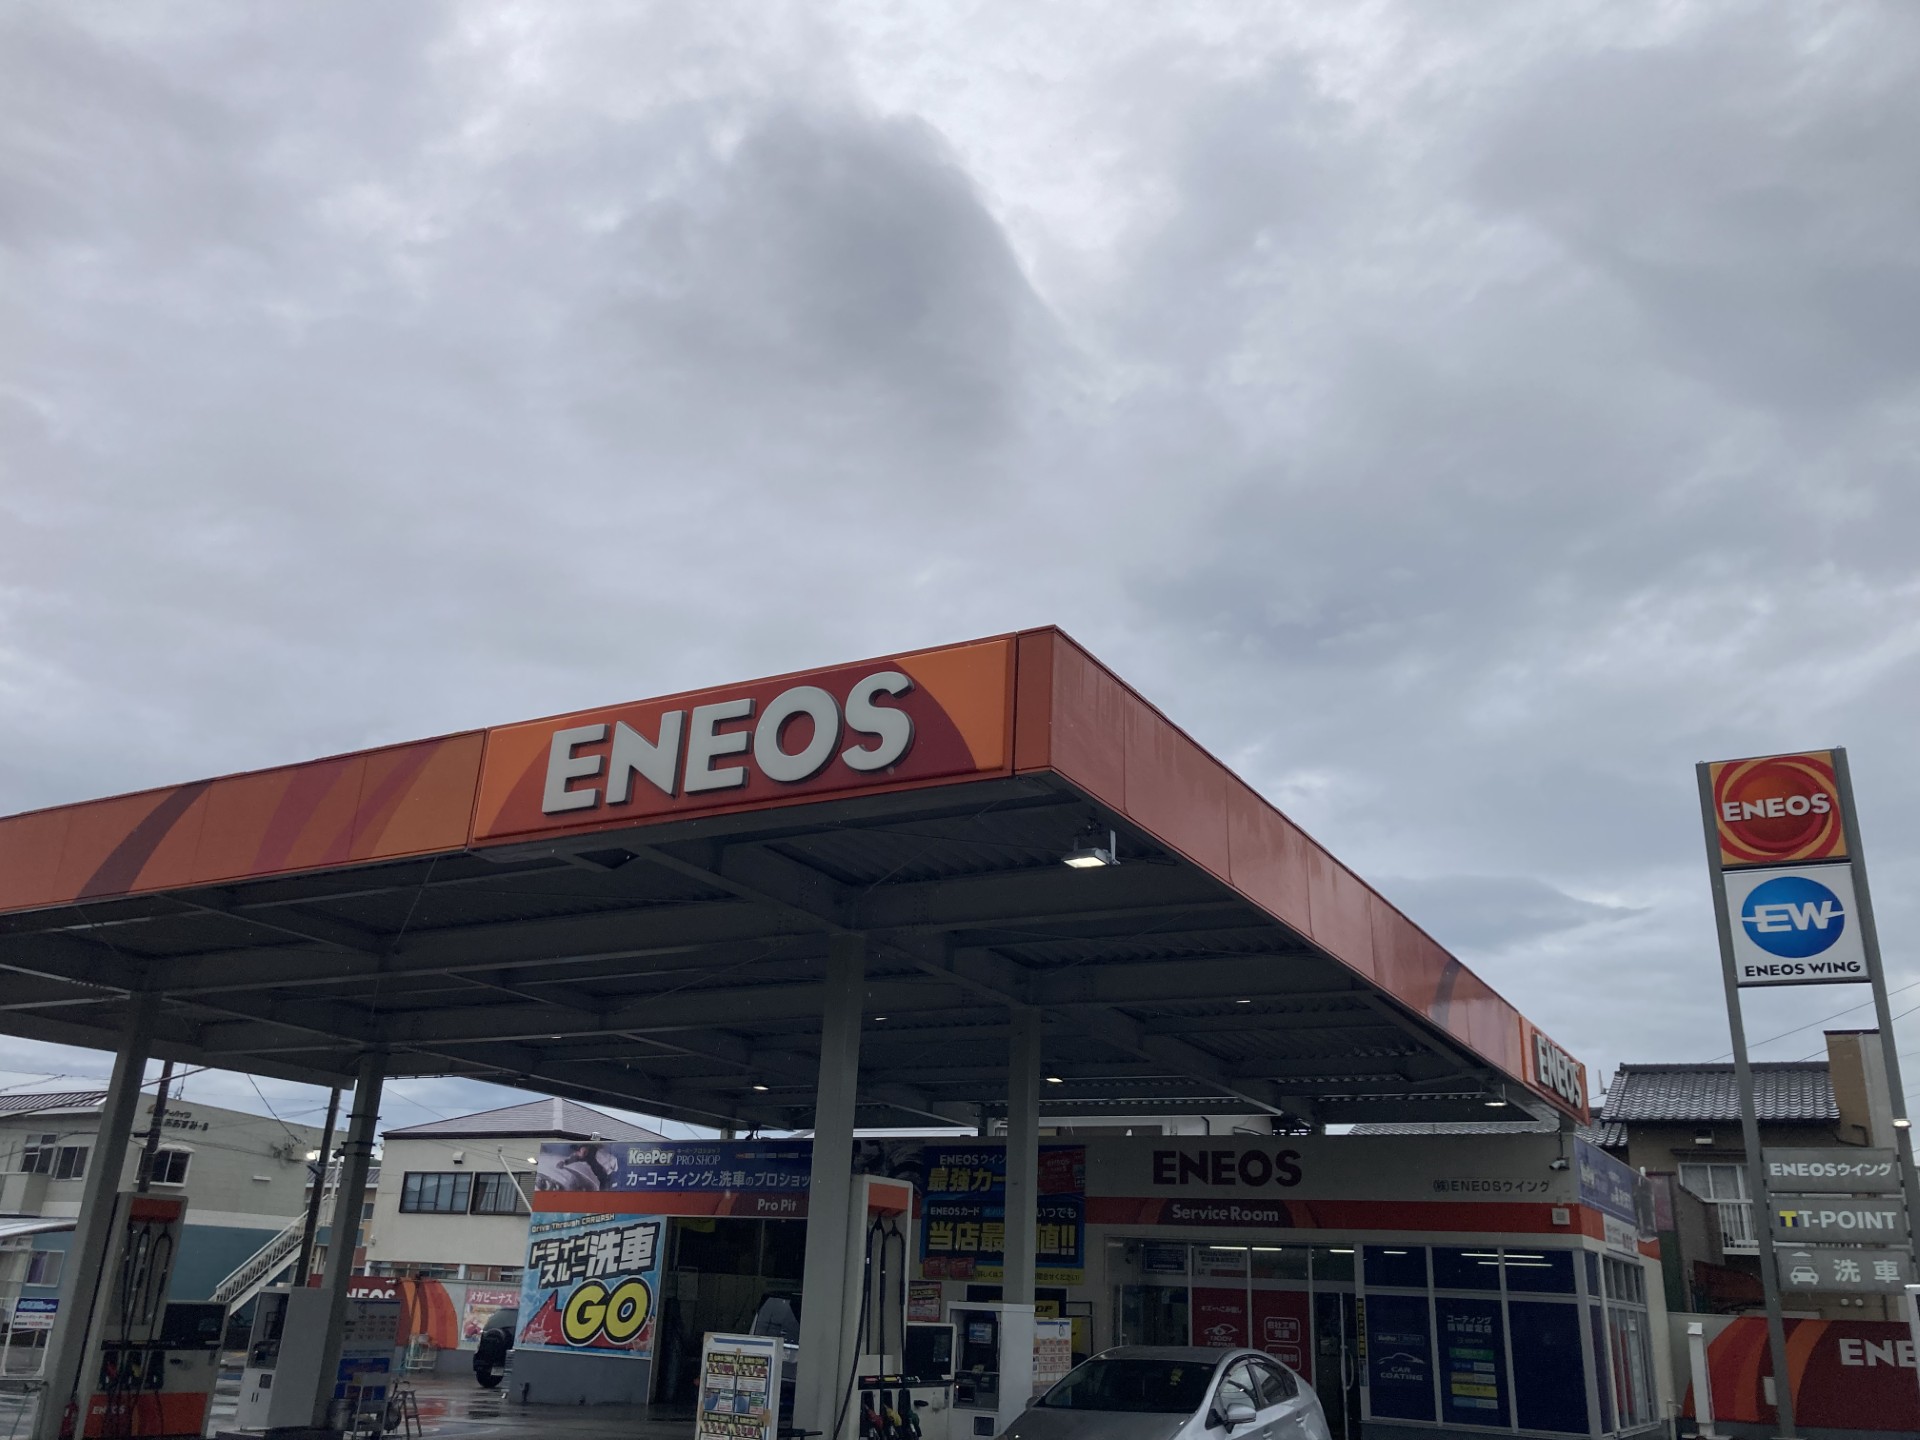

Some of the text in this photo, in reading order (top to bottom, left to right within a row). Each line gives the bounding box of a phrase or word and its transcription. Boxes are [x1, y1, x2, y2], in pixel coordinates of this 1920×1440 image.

[541, 670, 915, 813] ENEOS
[1721, 792, 1831, 823] ENEOS
[1744, 960, 1861, 977] ENEOS WING
[1535, 1033, 1583, 1110] ENEOS
[628, 1148, 674, 1166] KeePer
[676, 1154, 695, 1166] PRO
[695, 1154, 721, 1166] SHOP
[1153, 1149, 1303, 1187] ENEOS
[1769, 1162, 1892, 1177] ENEOSウイング
[757, 1198, 797, 1212] Pro Pit
[1172, 1204, 1279, 1222] Service Room
[1798, 1210, 1897, 1229] T-POINT
[530, 1235, 590, 1265] ドライブ
[585, 1225, 656, 1277] 洗車
[541, 1264, 586, 1287] スルー
[563, 1278, 651, 1345] GO
